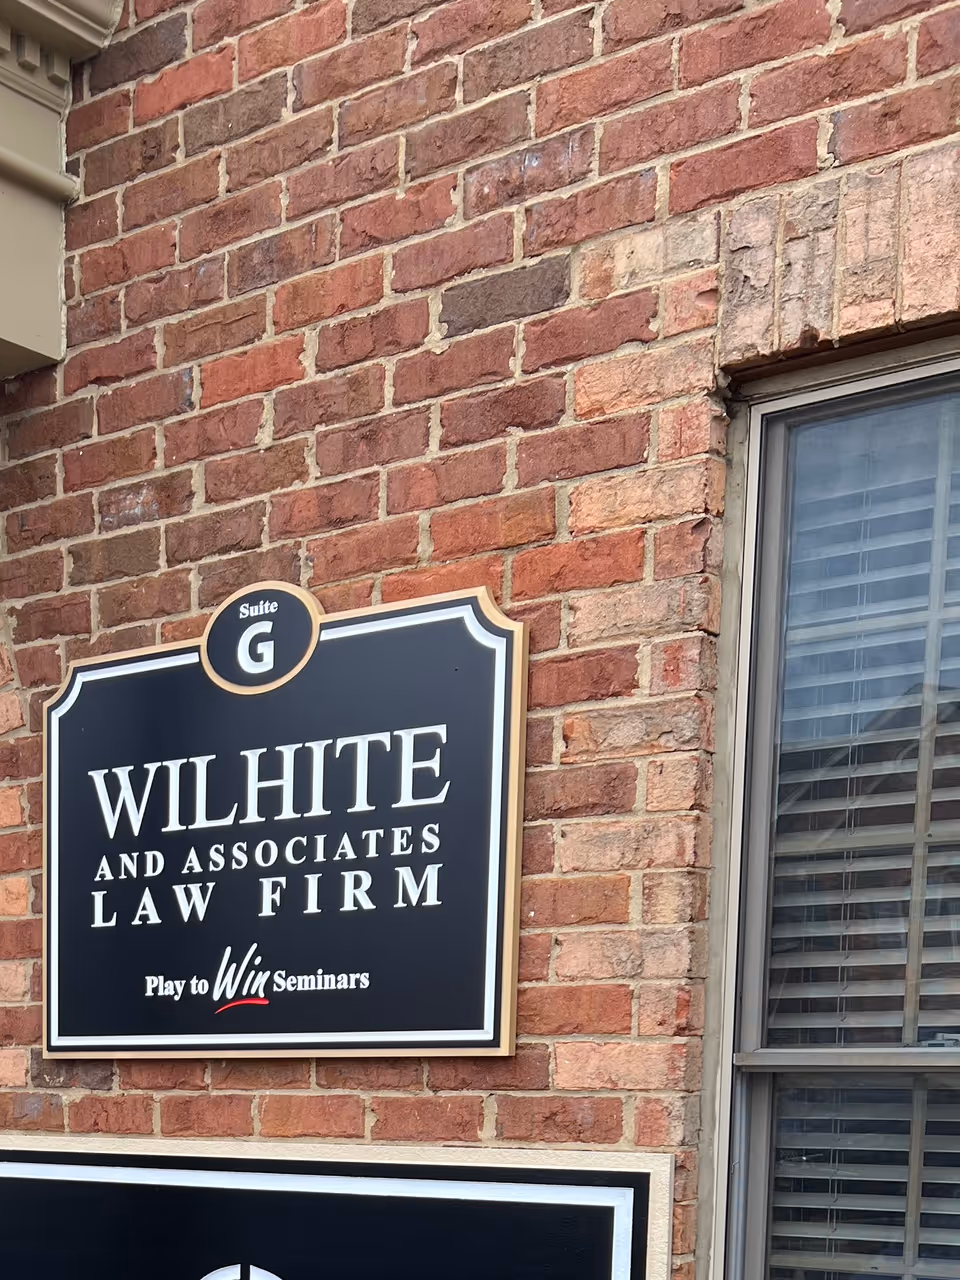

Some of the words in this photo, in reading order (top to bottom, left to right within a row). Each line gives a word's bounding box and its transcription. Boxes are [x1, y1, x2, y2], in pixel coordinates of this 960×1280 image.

[239, 599, 279, 619] Suite
[237, 620, 275, 674] G
[87, 724, 451, 840] WILHITE
[94, 850, 165, 882] AND
[182, 823, 441, 874] ASSOCIATES
[91, 882, 216, 928] LAW
[258, 863, 444, 918] FIRM
[145, 975, 187, 1000] Play
[190, 974, 209, 994] to
[212, 943, 269, 1001] Win
[273, 970, 370, 993] Seminars
